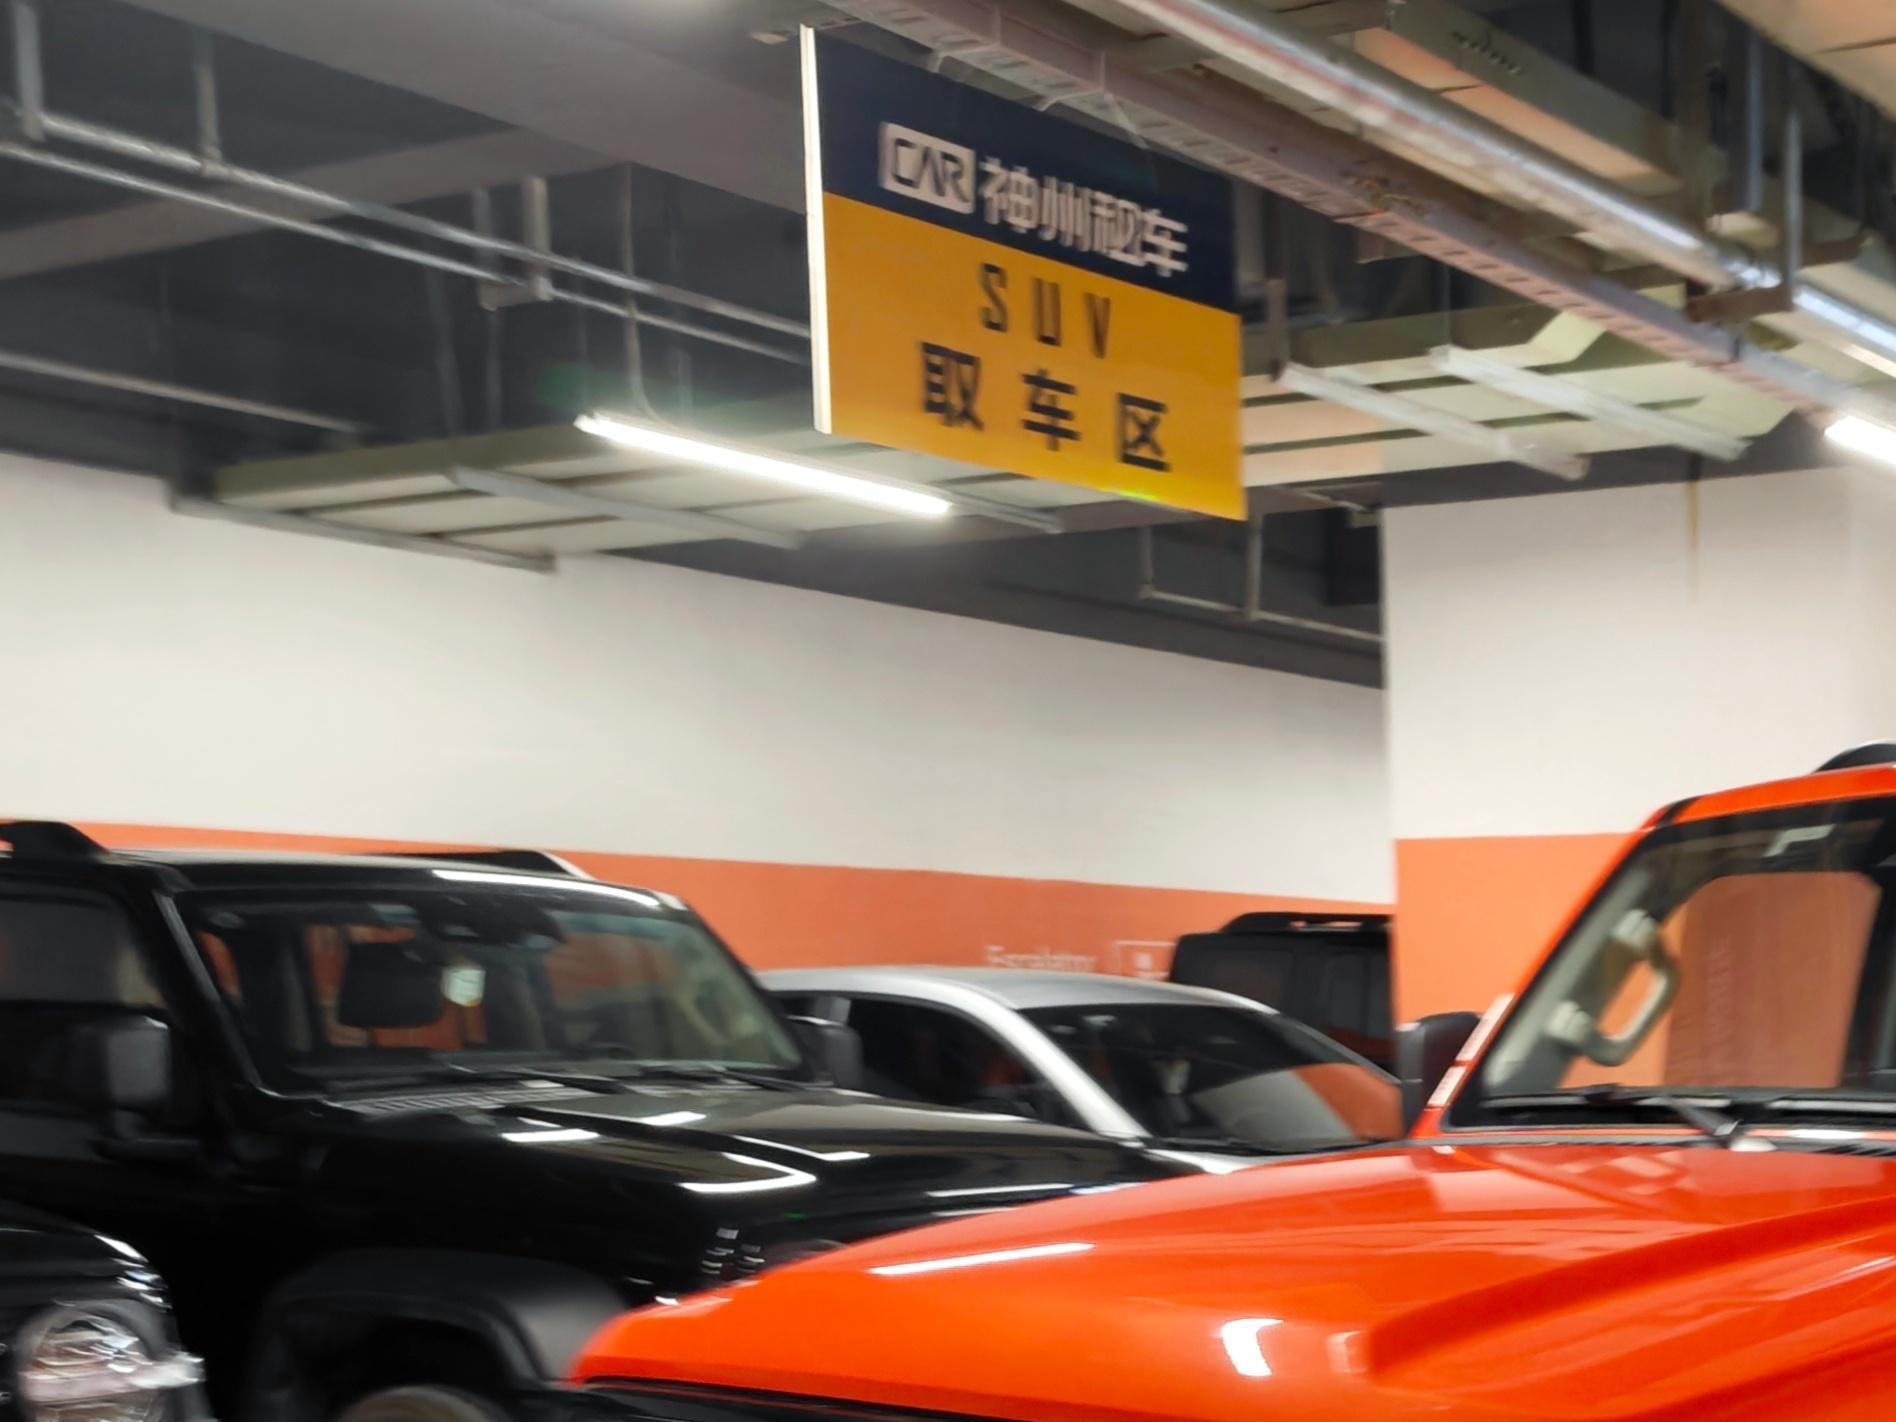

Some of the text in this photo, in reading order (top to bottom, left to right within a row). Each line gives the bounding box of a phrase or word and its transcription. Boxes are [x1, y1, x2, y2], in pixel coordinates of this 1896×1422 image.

[891, 136, 970, 202] CAR
[978, 155, 1189, 277] 神州租车
[919, 341, 1172, 472] 取车区
